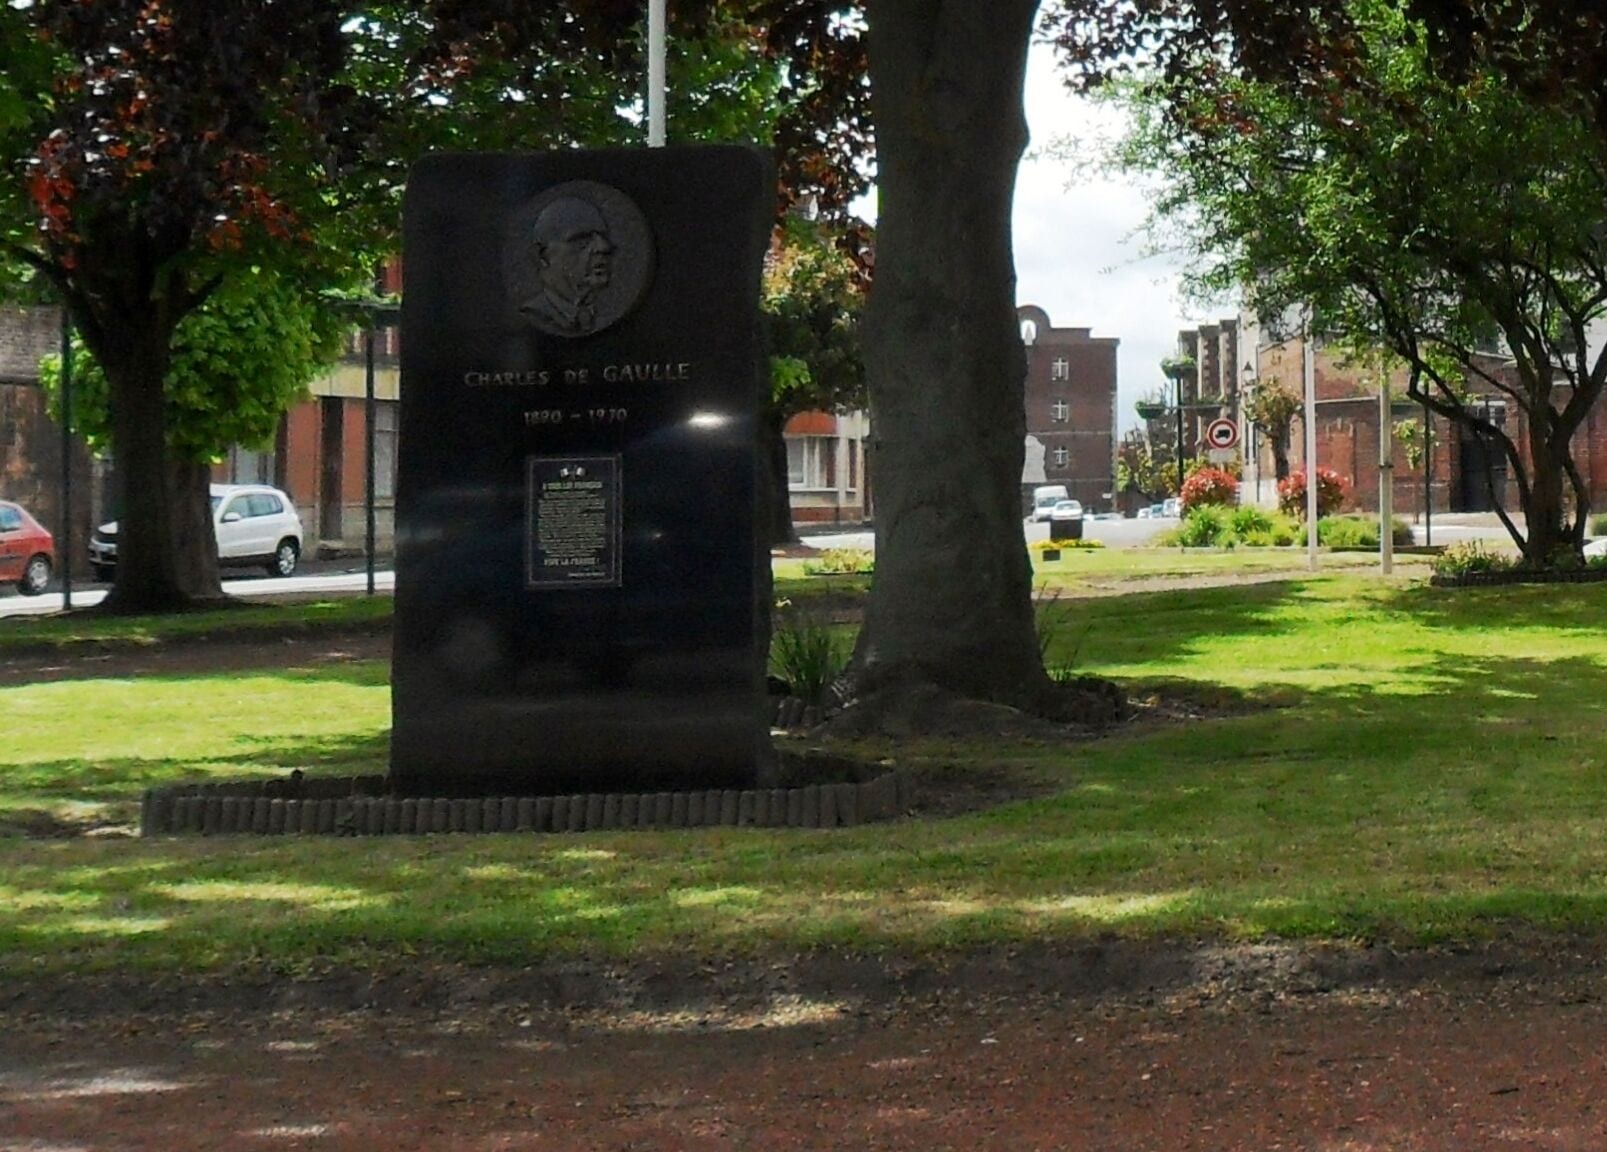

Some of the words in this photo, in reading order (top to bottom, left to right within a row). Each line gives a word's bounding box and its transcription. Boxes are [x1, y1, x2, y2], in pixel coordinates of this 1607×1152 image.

[464, 369, 550, 388] CHARLES
[564, 368, 590, 385] DE
[603, 362, 691, 383] GAULLE
[524, 409, 562, 426] 1890
[589, 407, 628, 424] 1970
